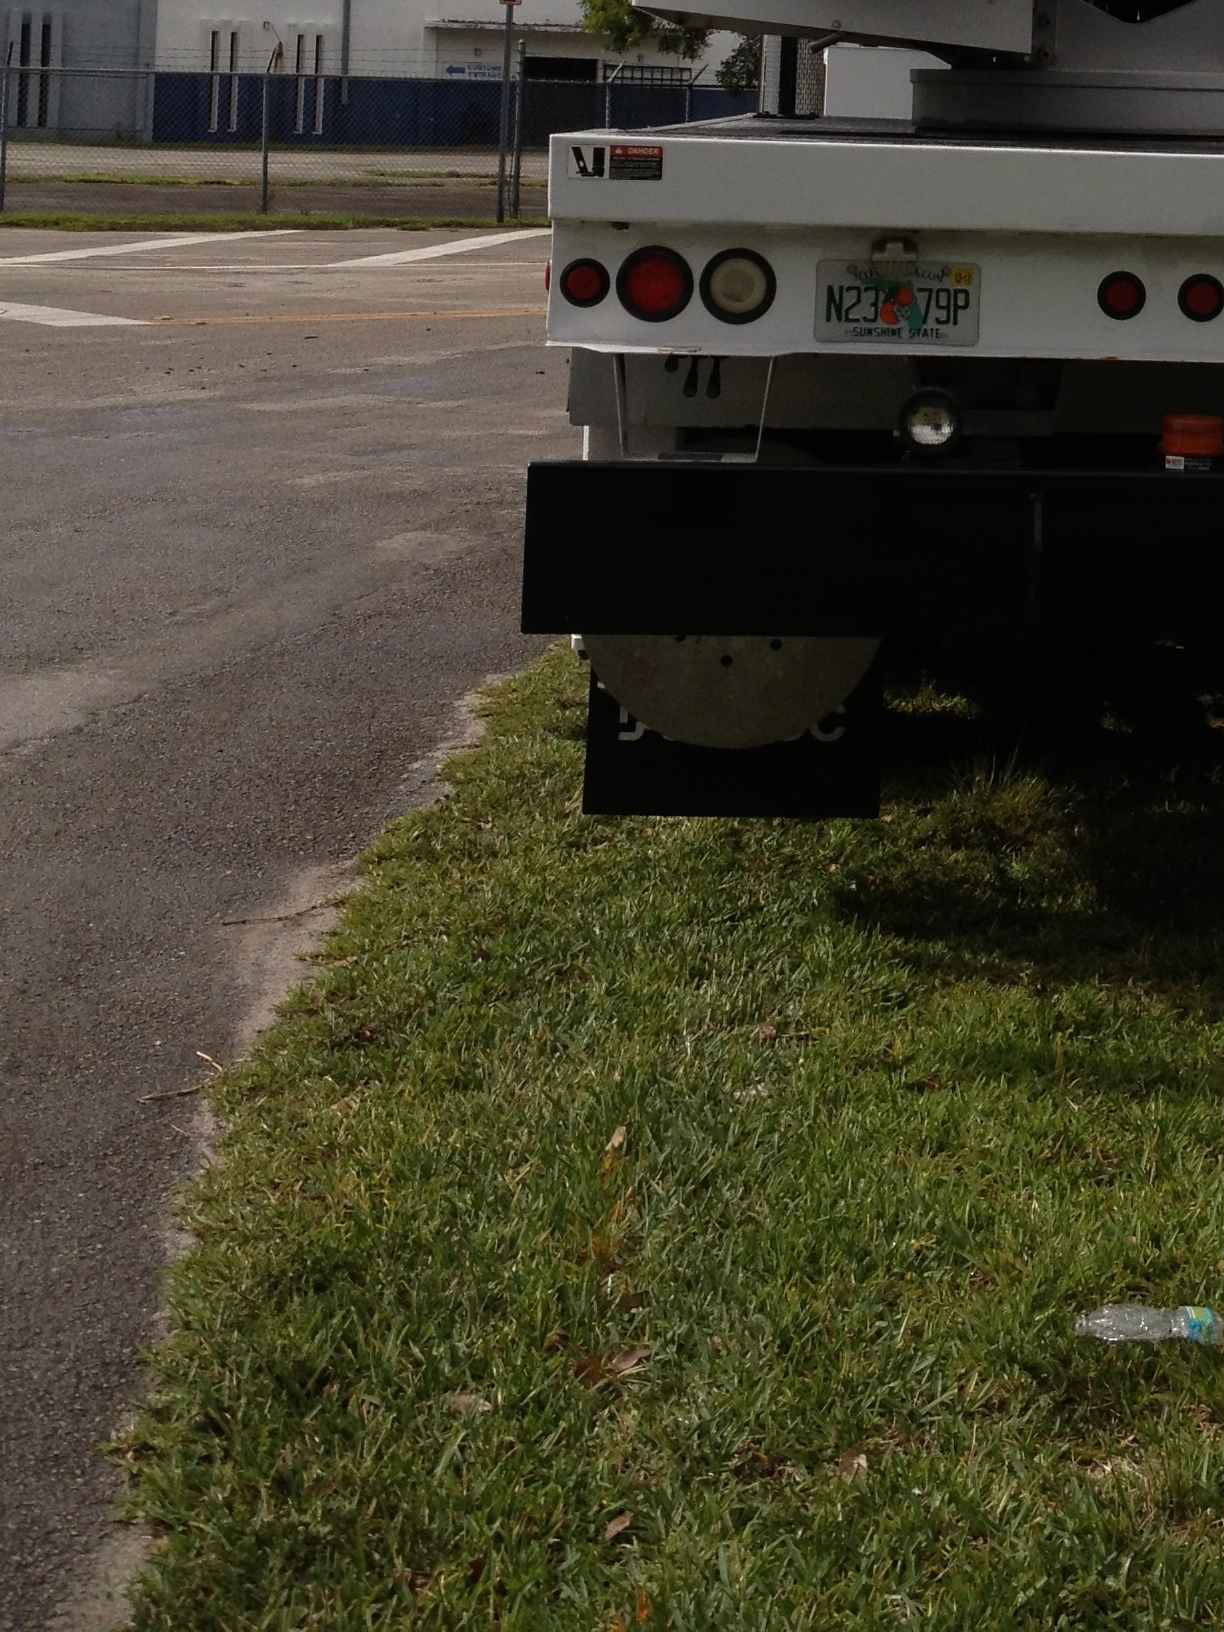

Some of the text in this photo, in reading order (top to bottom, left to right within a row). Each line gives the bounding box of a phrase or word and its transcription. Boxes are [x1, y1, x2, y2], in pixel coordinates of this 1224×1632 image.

[916, 287, 970, 326] 79P
[852, 326, 941, 339] SUNSHINE STATE
